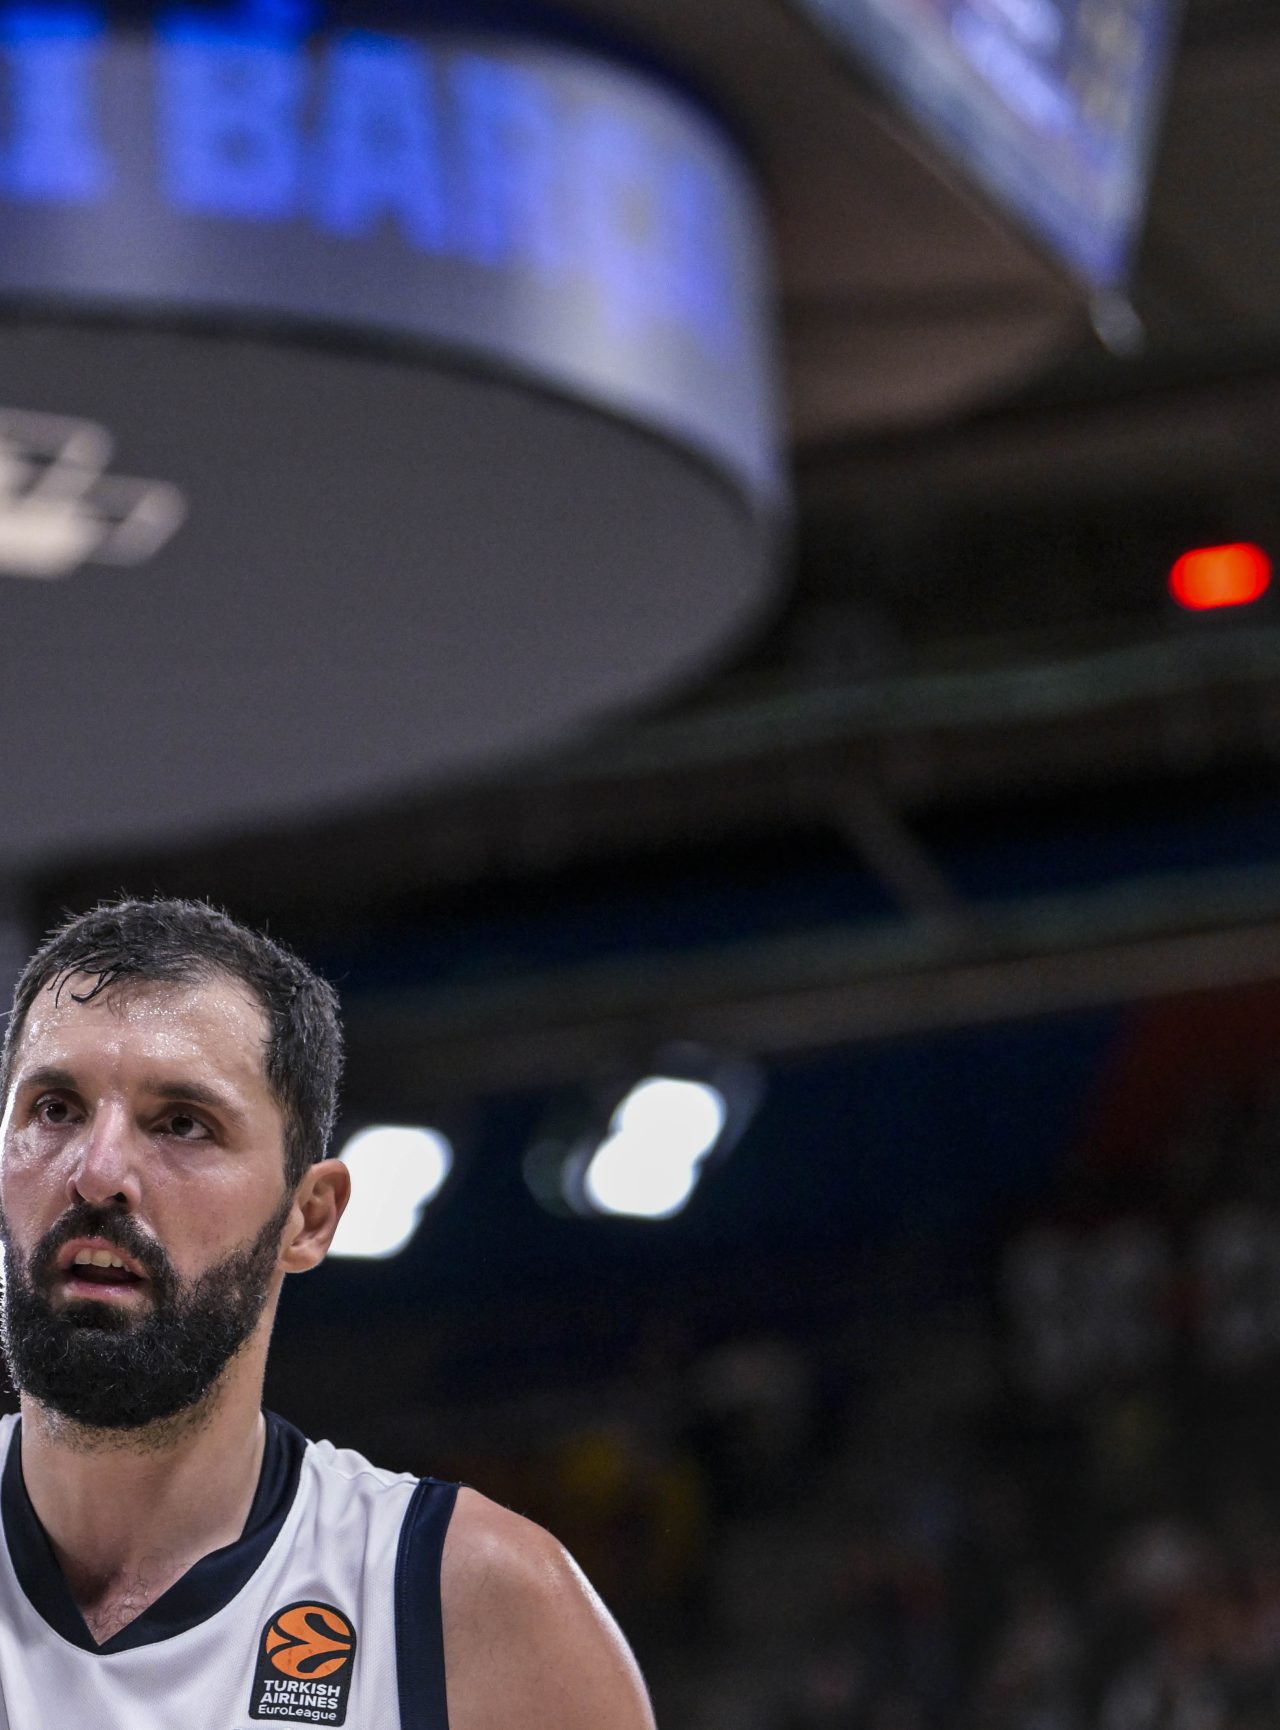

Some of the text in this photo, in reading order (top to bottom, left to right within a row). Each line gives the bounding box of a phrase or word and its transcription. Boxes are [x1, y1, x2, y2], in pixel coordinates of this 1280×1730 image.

[264, 1680, 340, 1697] TURKISH
[260, 1693, 338, 1709] AIRLINES
[258, 1704, 337, 1720] EuroLeague
